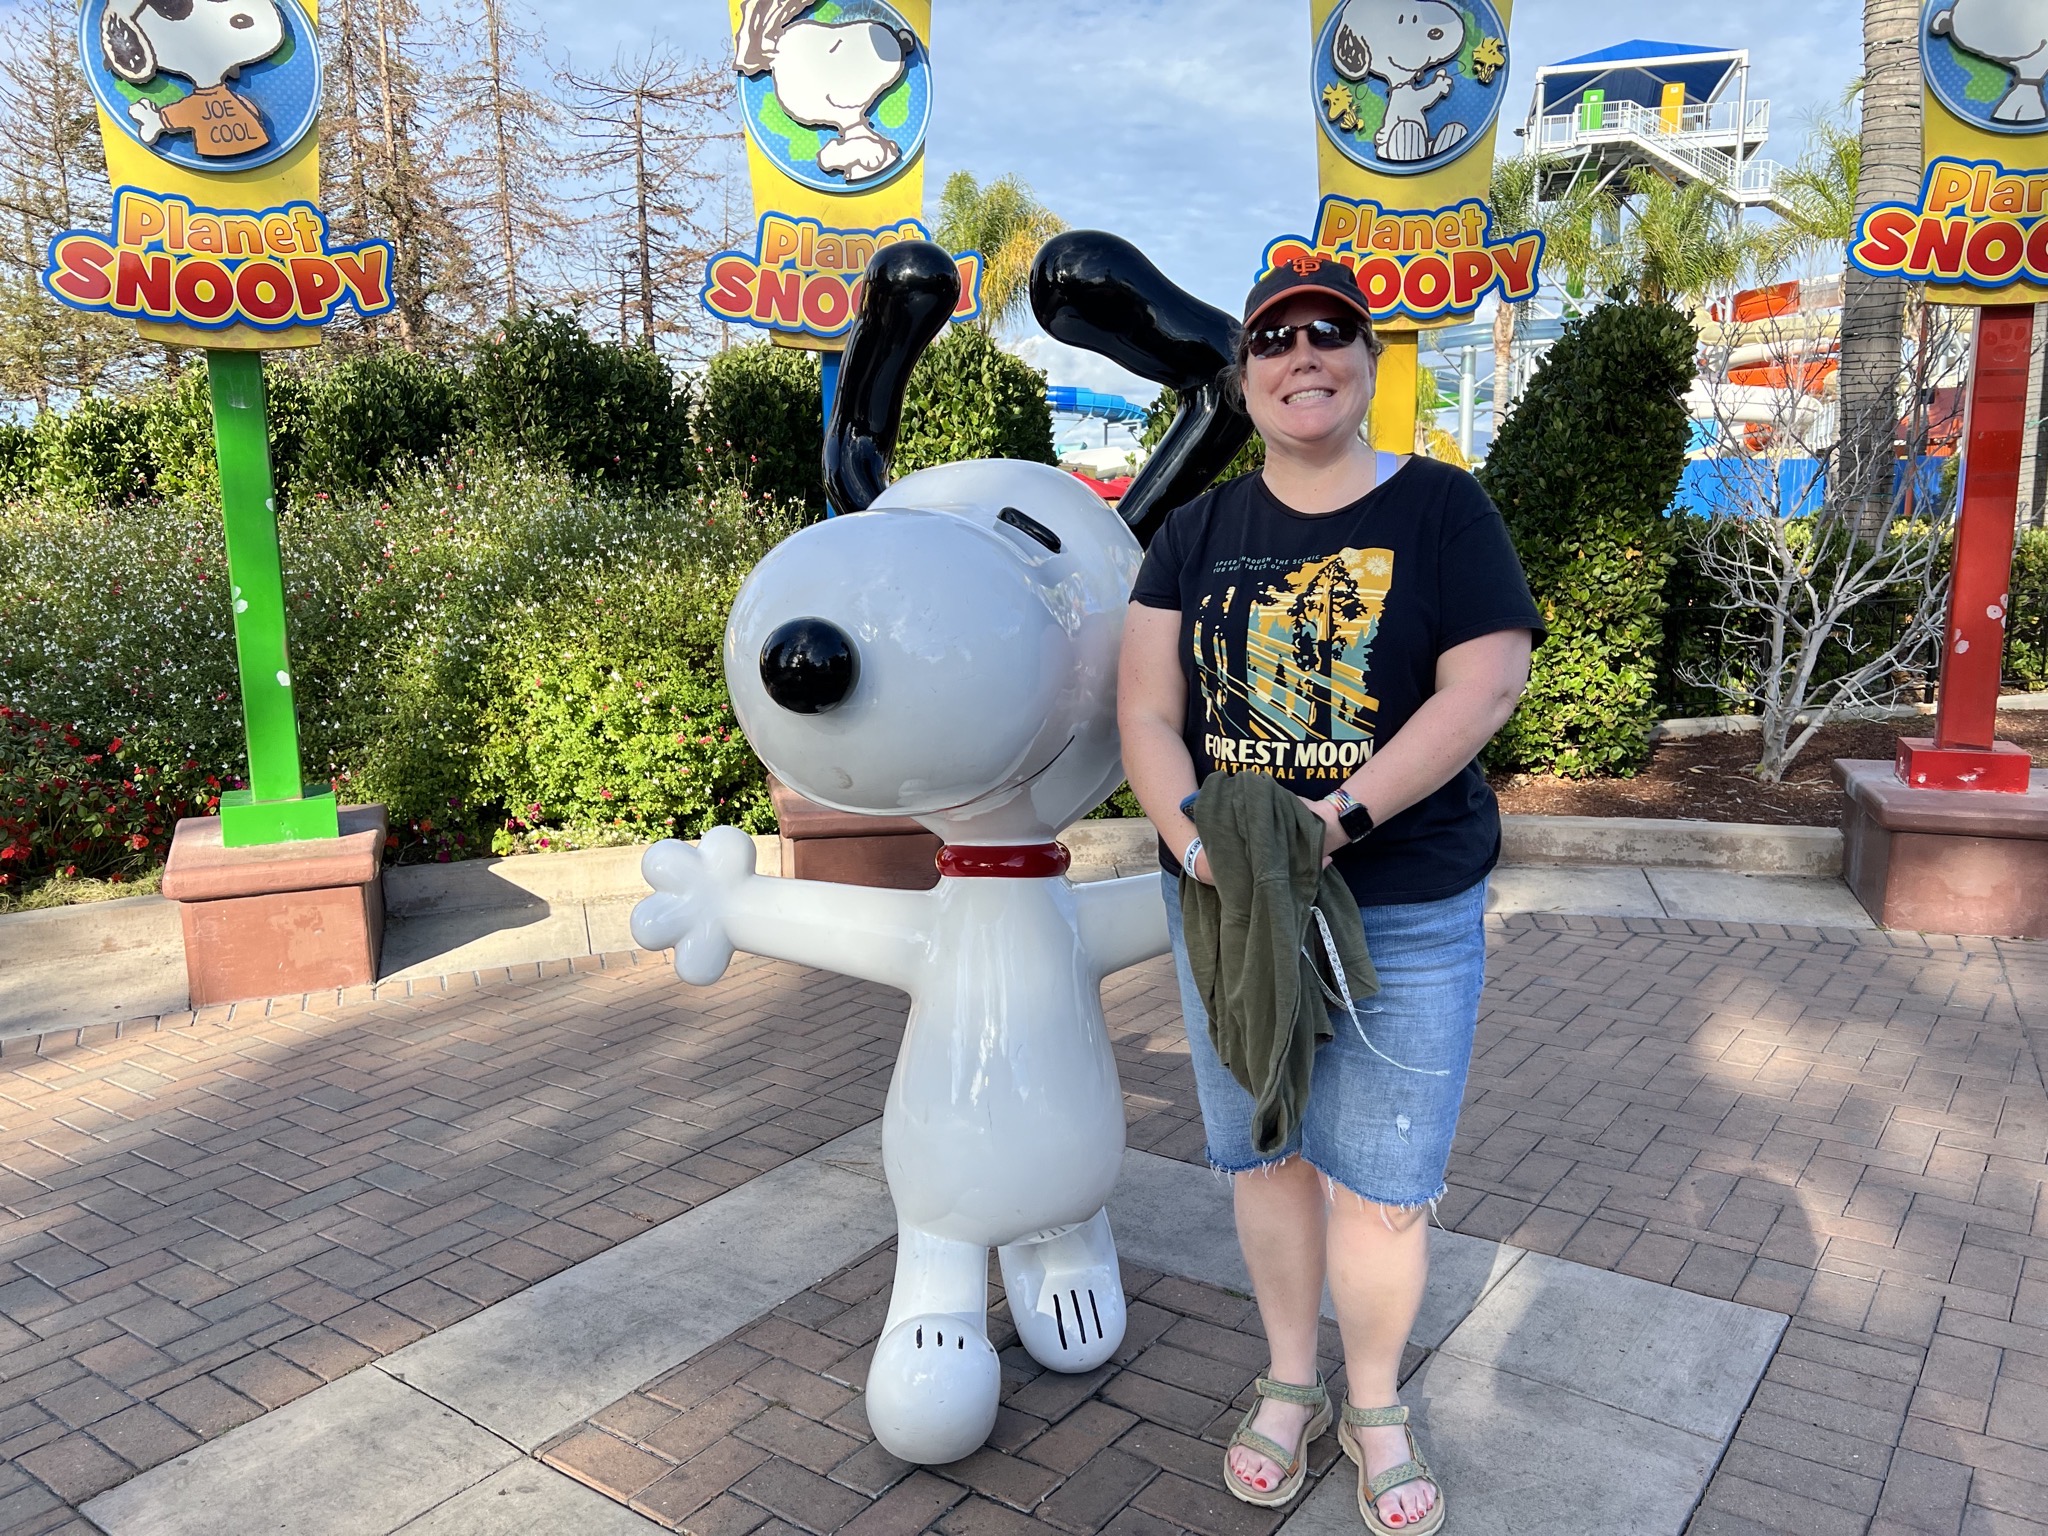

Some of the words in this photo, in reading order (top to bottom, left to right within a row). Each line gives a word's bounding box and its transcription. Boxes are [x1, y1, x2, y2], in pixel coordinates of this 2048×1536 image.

[201, 99, 236, 121] JOE
[209, 121, 258, 144] COOL
[123, 197, 319, 255] Planet
[1321, 204, 1483, 250] Planet
[764, 220, 921, 269] Plan
[55, 240, 383, 319] SNOOPY
[1272, 240, 1536, 308] OOPY
[1215, 559, 1238, 568] SPEED
[1292, 554, 1320, 565] SCENIC
[1244, 563, 1267, 571] TREES
[1204, 733, 1291, 766] FOREST
[1294, 738, 1375, 767] MOON
[1305, 767, 1353, 780] PARK
